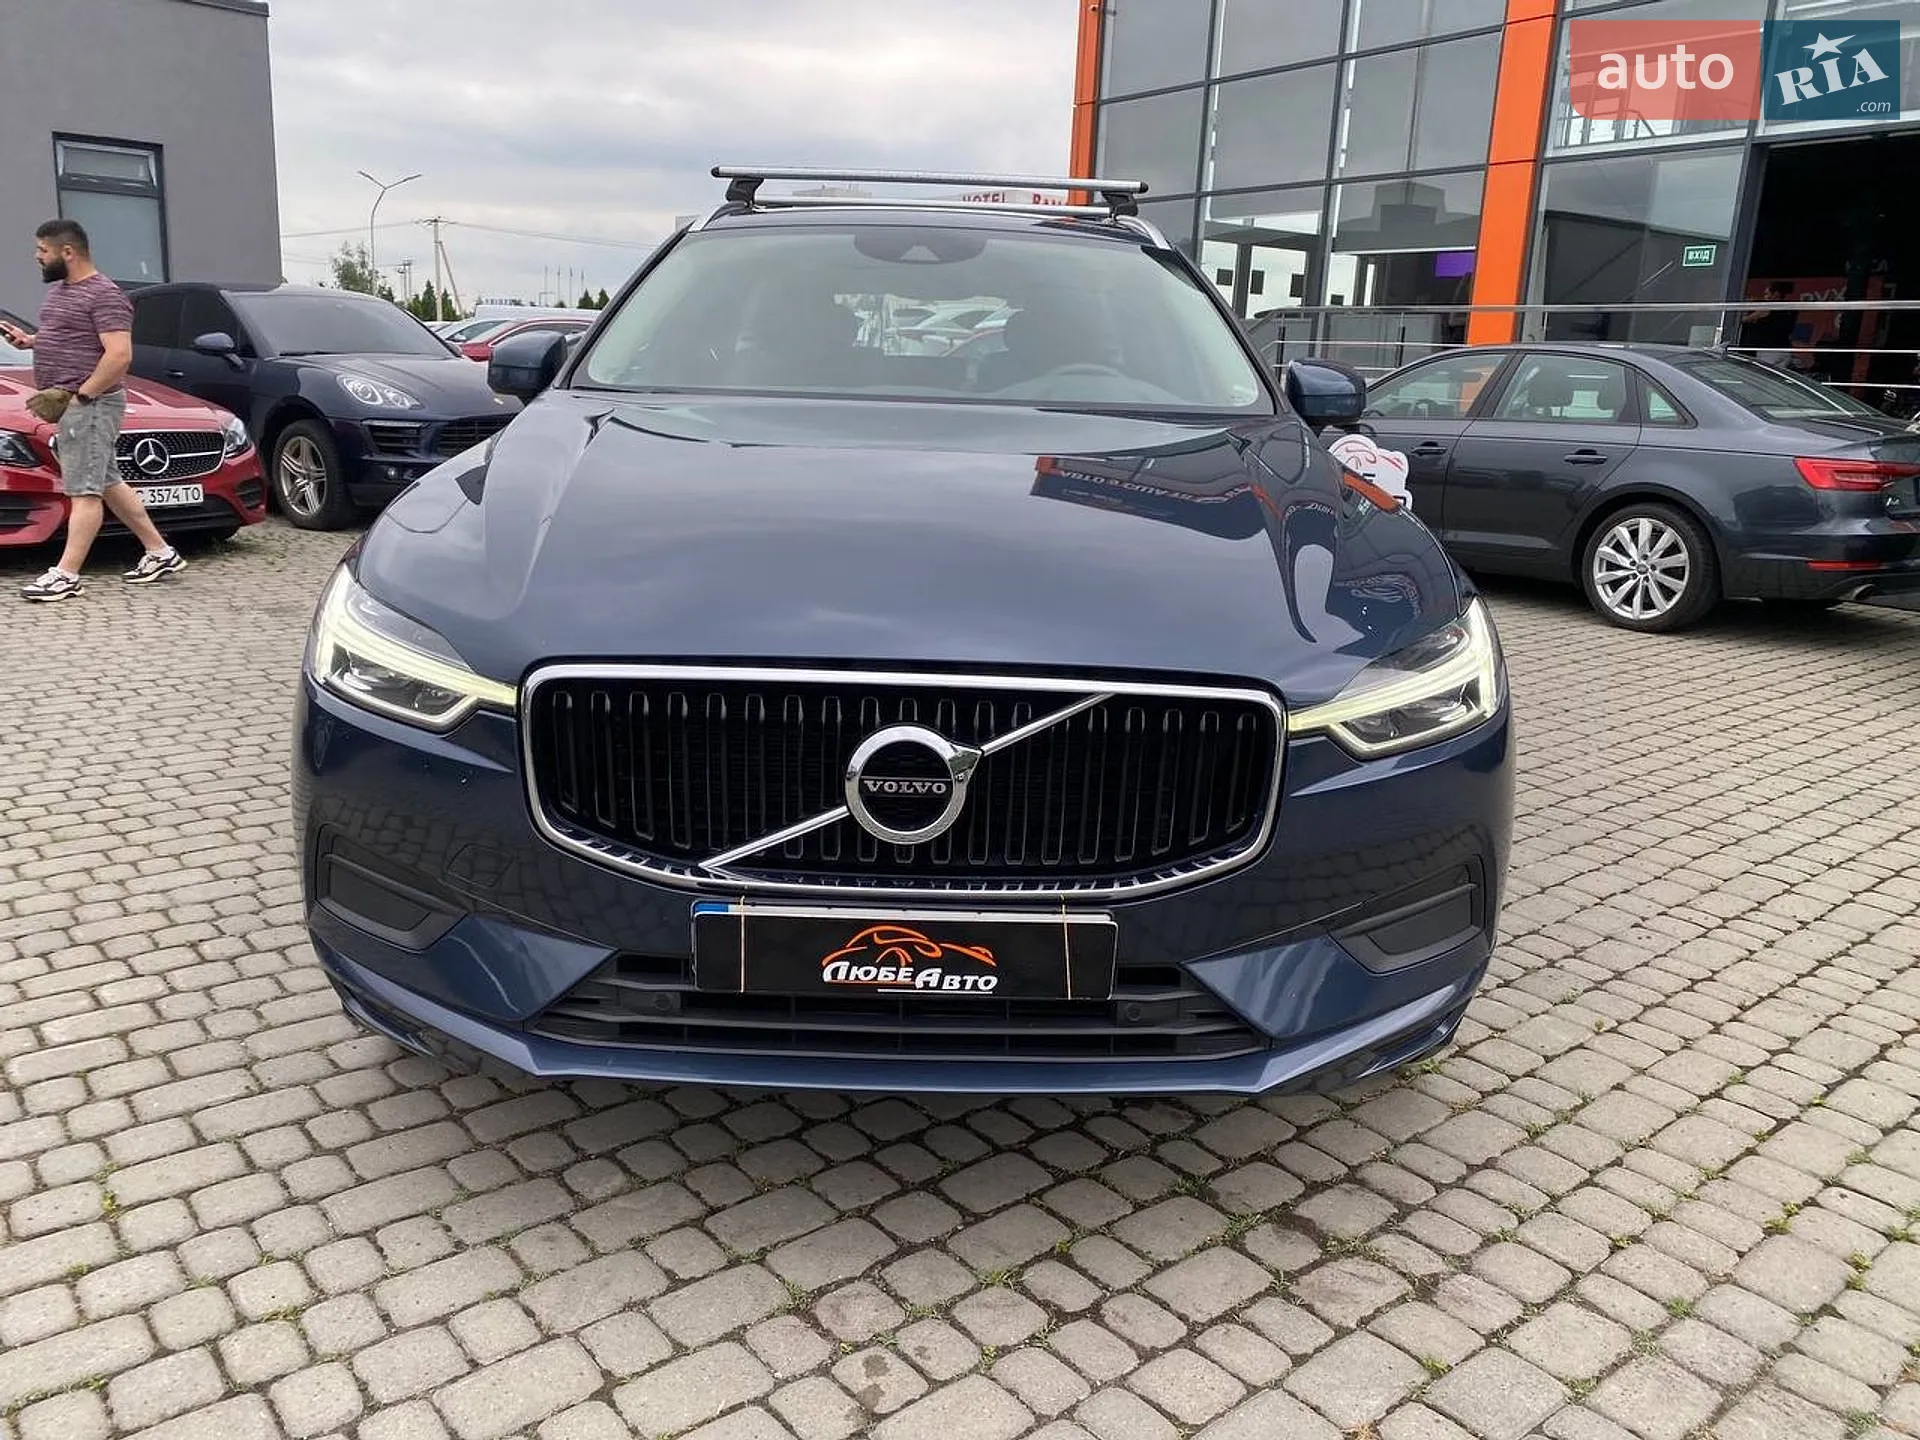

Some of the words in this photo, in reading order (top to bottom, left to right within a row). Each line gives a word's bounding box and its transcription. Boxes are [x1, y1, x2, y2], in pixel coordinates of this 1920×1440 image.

[148, 487, 180, 504] 3574
[182, 486, 201, 501] TO
[863, 780, 947, 794] VOLVO
